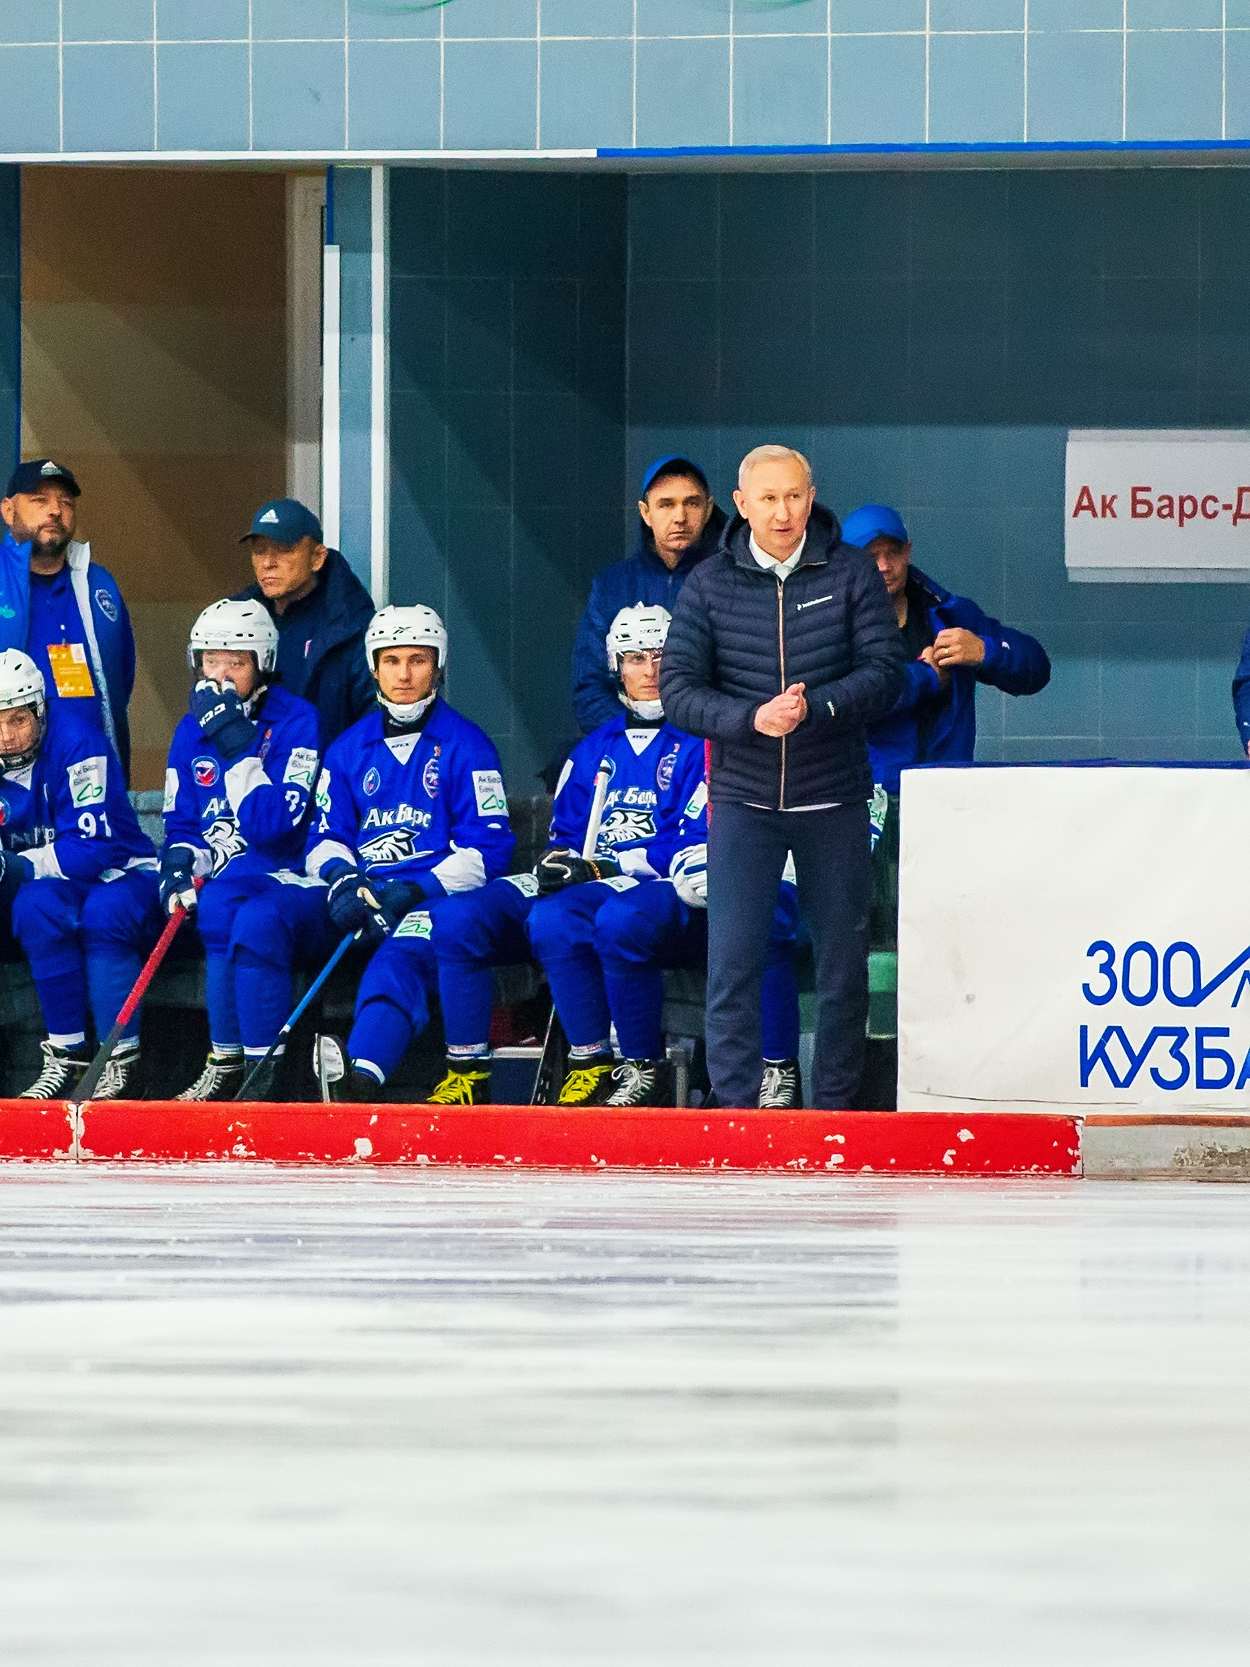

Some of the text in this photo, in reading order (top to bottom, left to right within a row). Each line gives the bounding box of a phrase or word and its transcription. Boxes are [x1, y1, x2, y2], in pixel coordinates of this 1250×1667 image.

[1072, 485, 1118, 518] Ак
[77, 811, 112, 838] 91
[363, 808, 394, 829] Ак
[1082, 940, 1201, 1008] 300
